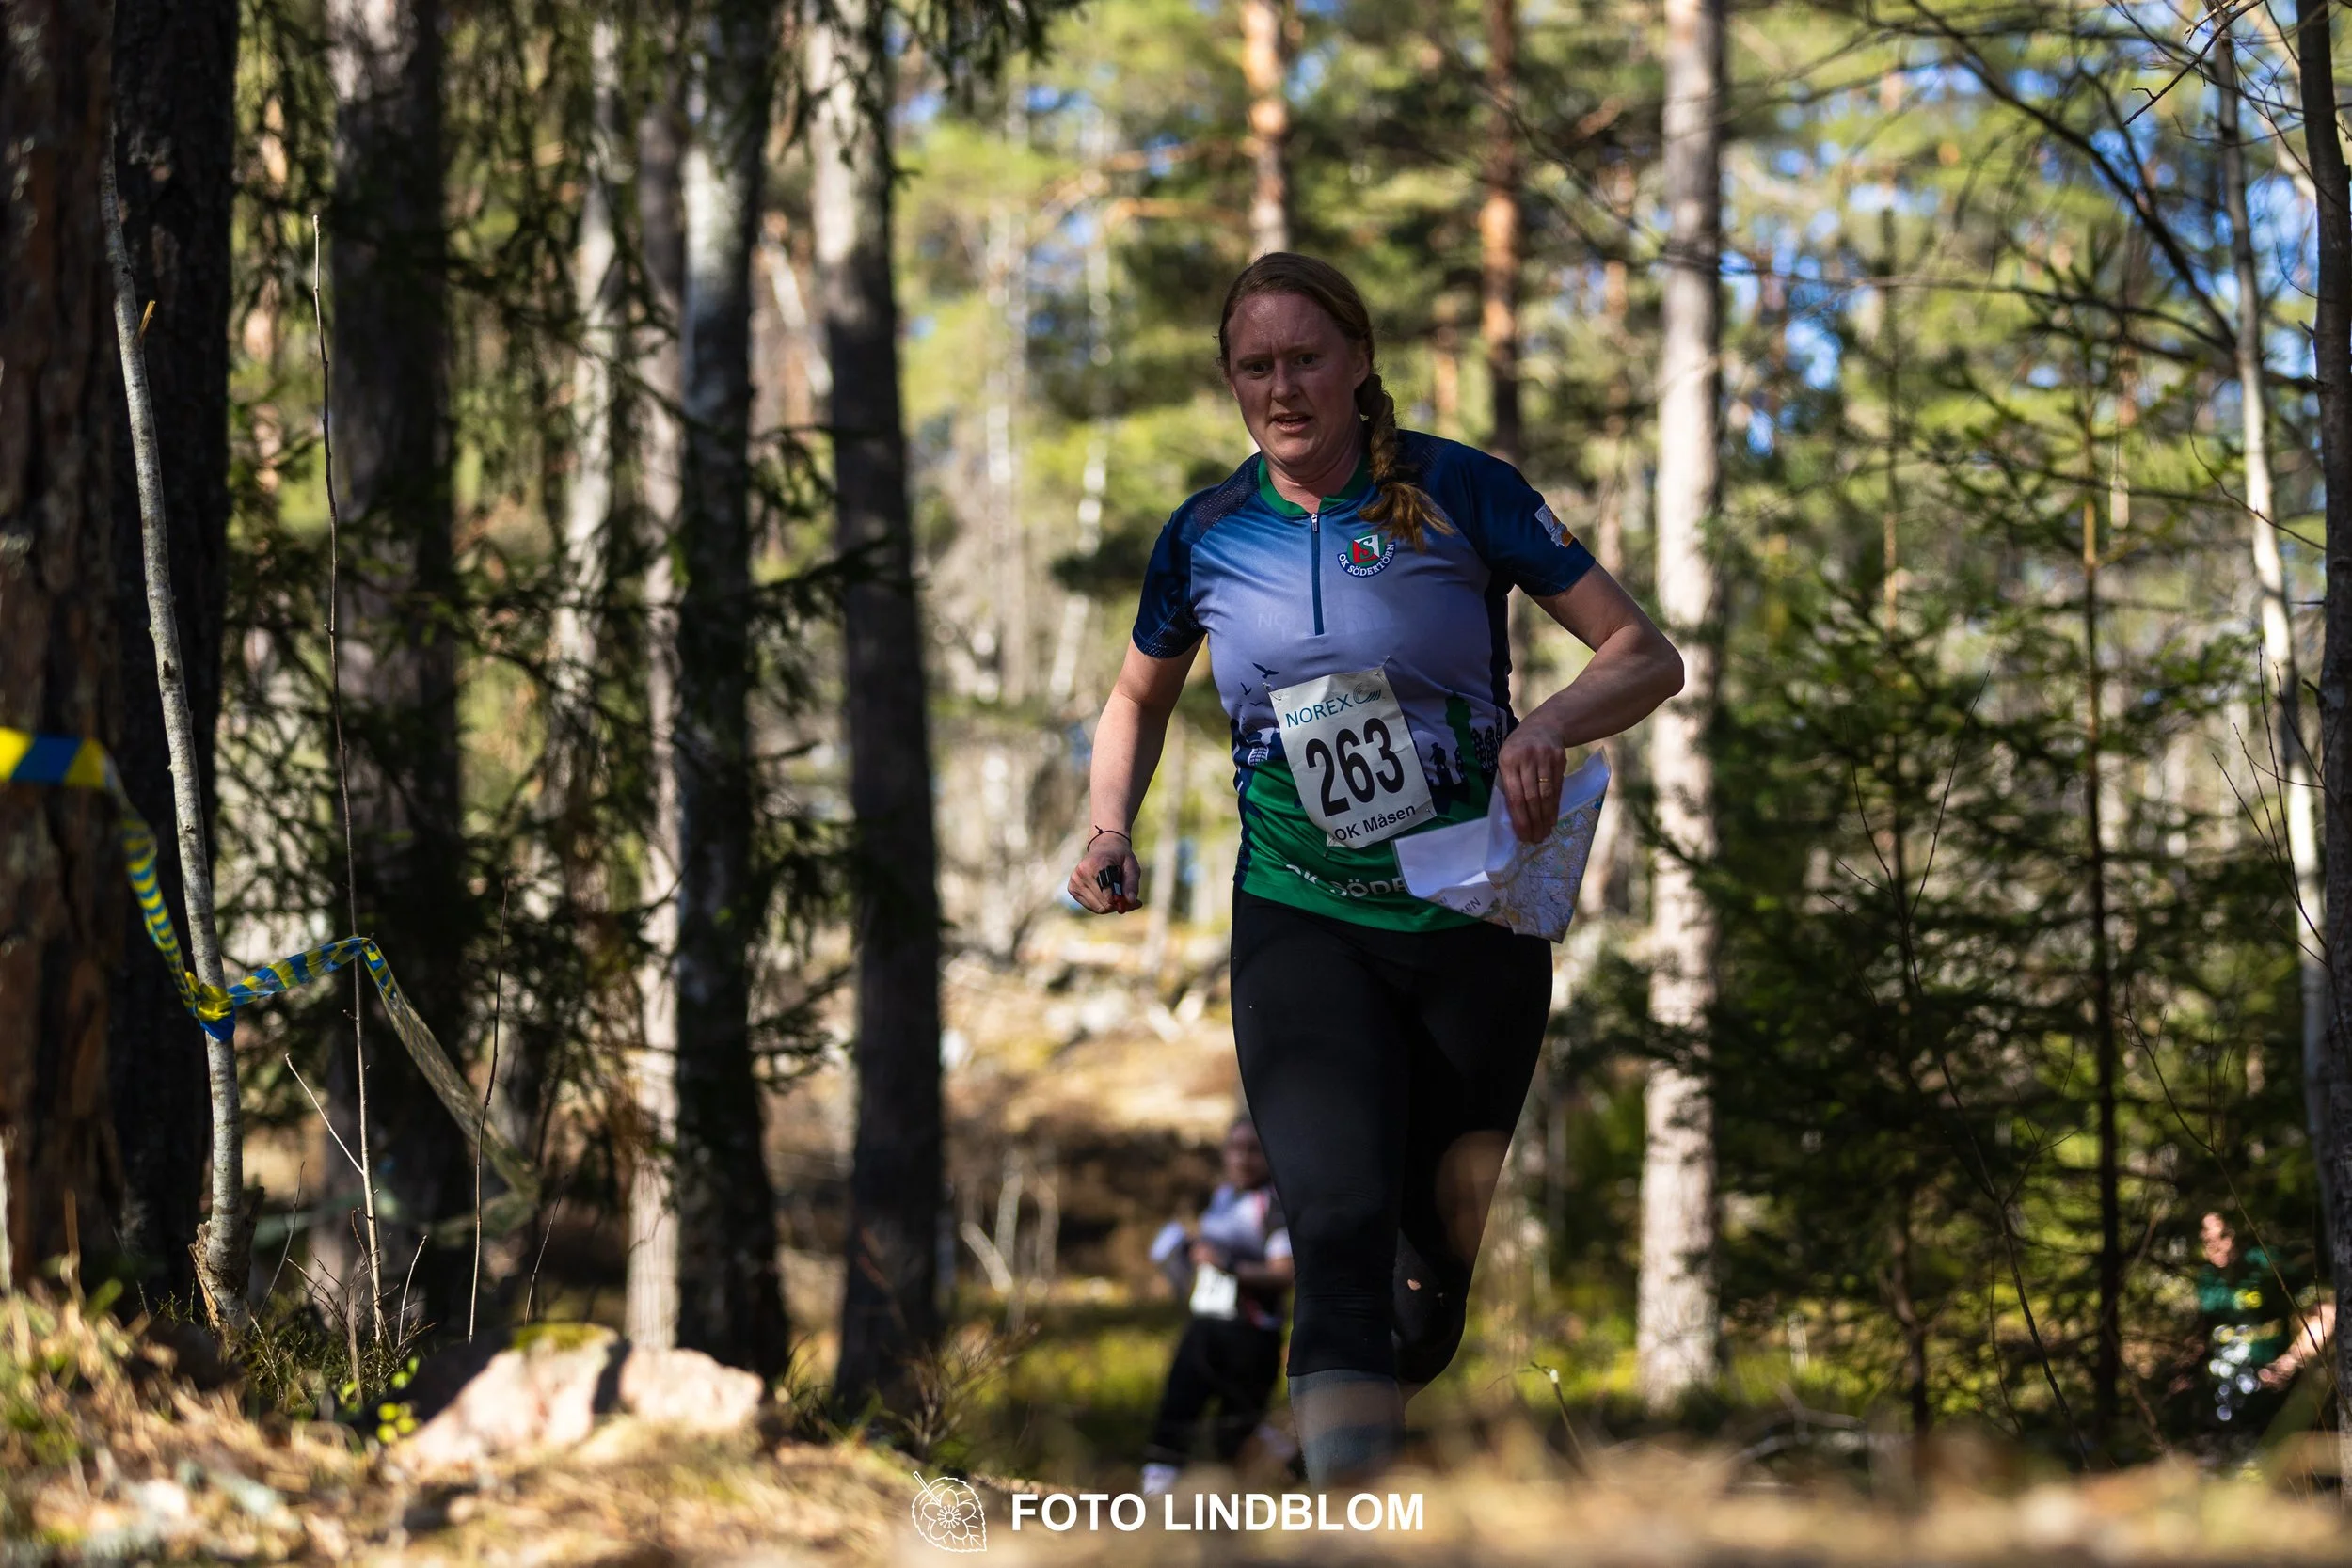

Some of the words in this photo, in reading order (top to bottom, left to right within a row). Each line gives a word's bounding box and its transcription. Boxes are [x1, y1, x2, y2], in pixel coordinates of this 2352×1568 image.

[1339, 553, 1349, 568] OK
[1347, 544, 1394, 576] SÖDERTÖRN
[1285, 694, 1353, 727] NOREX
[1305, 717, 1405, 817] 263
[1334, 823, 1360, 841] OK
[1362, 805, 1416, 832] Måsen
